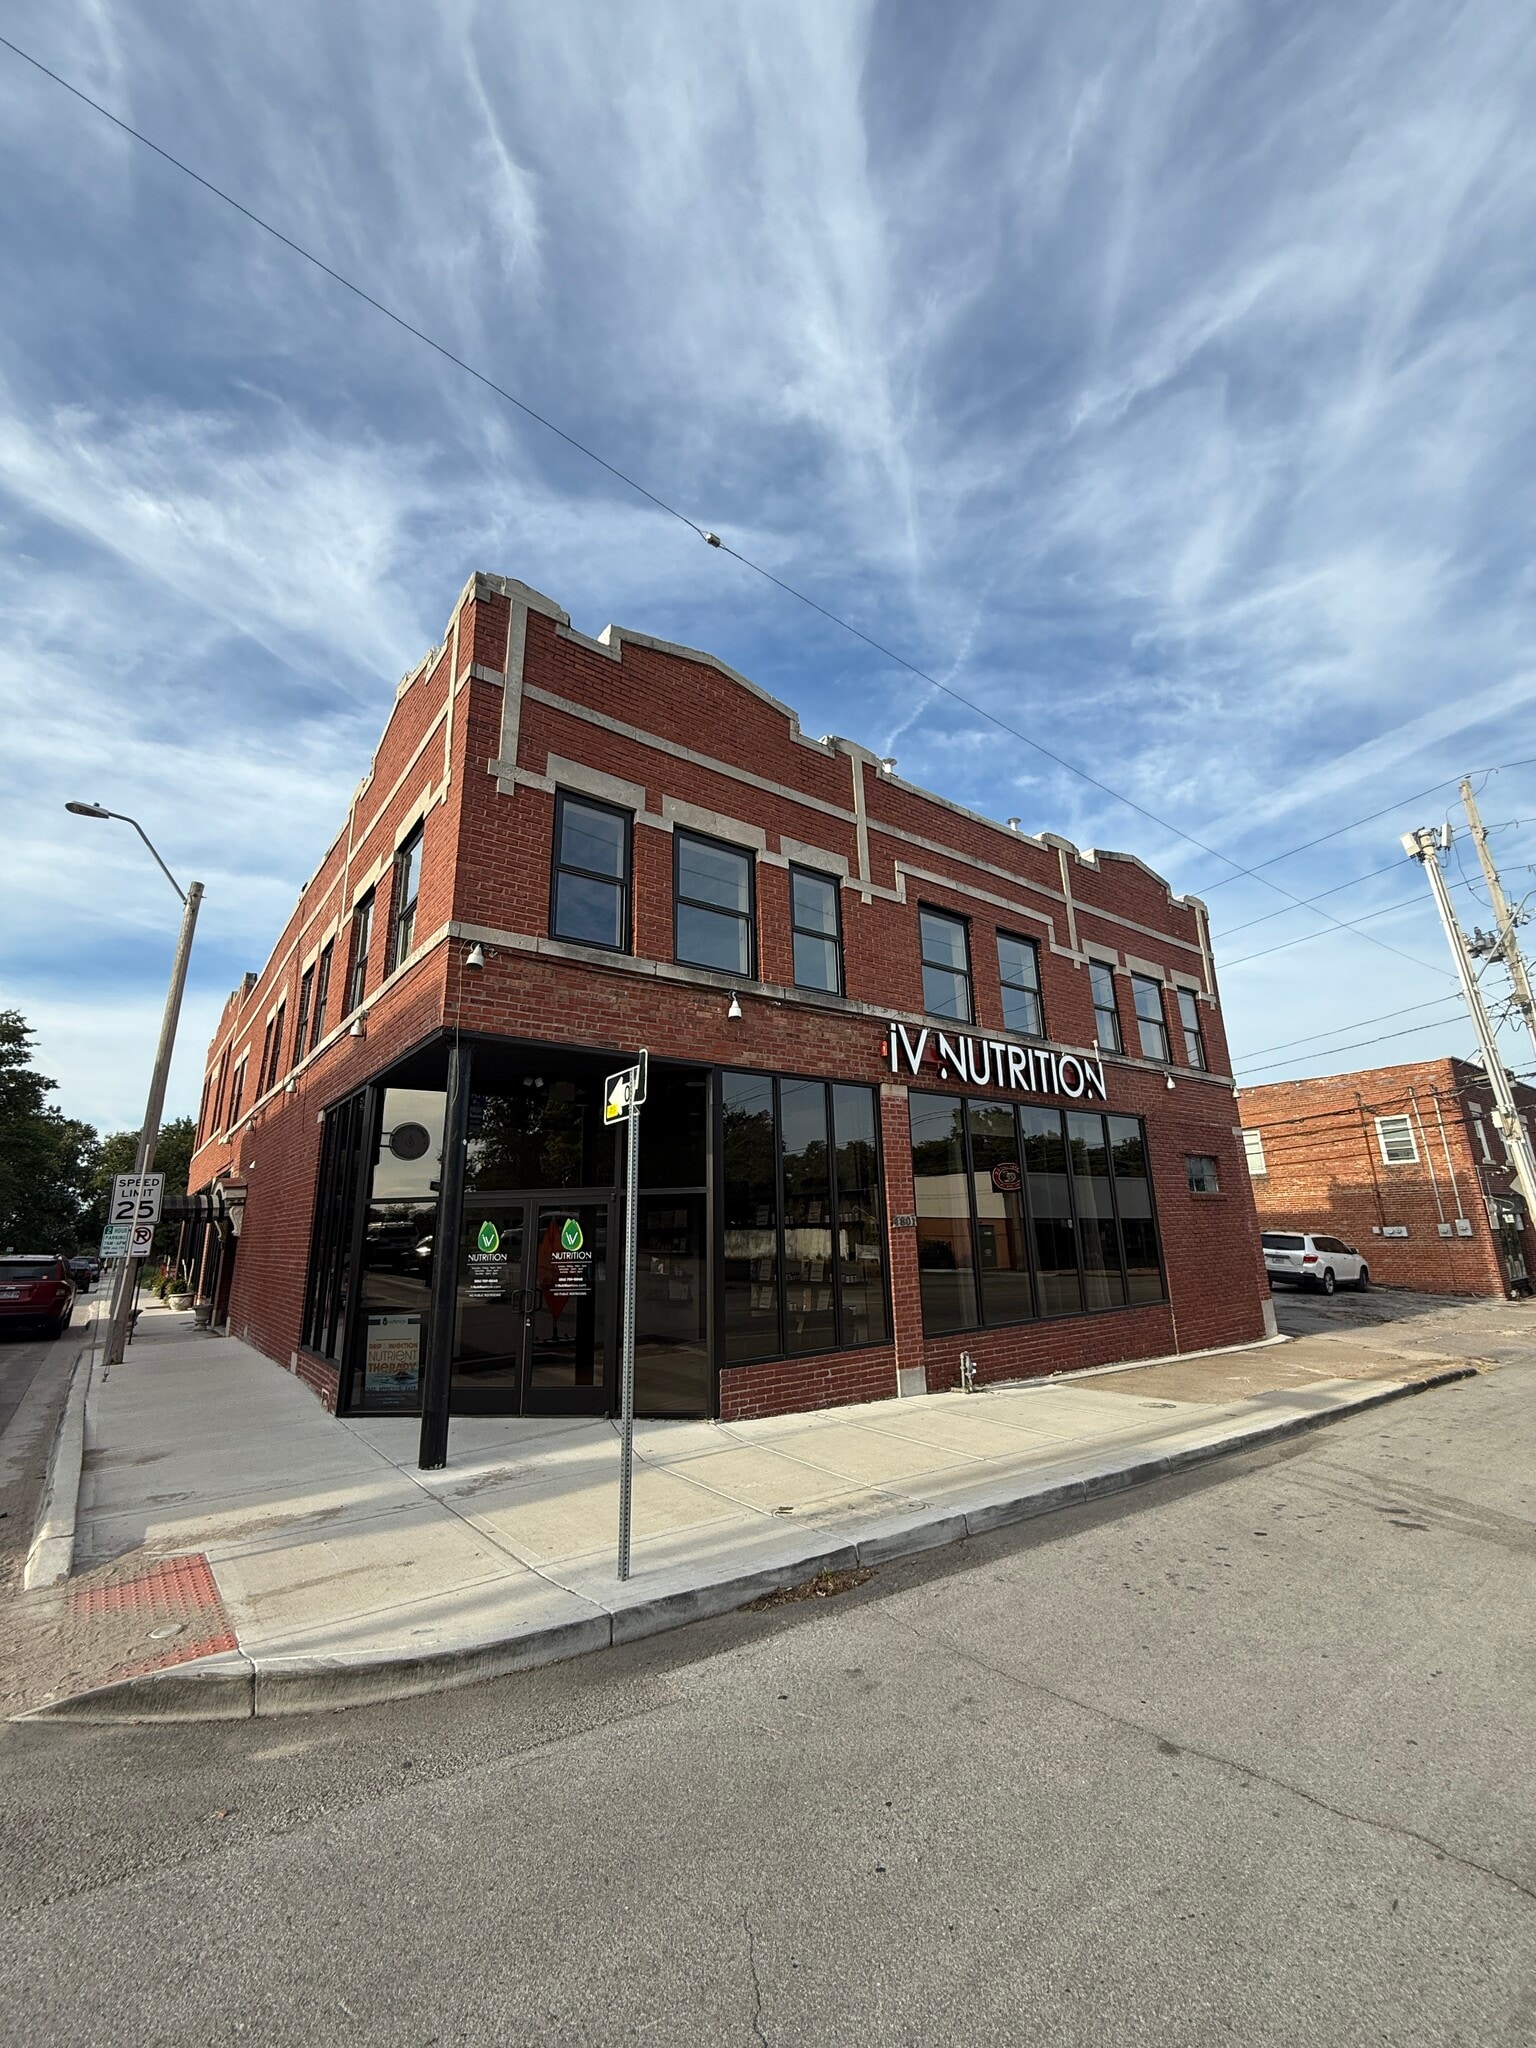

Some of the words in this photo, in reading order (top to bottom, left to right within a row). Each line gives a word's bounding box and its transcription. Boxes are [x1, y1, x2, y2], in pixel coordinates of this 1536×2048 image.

[938, 1031, 1107, 1101] NUTRITION
[118, 1178, 160, 1187] SPEED
[116, 1200, 154, 1220] 25
[467, 1253, 508, 1262] NUTRITION
[551, 1251, 592, 1260] NUTRITION
